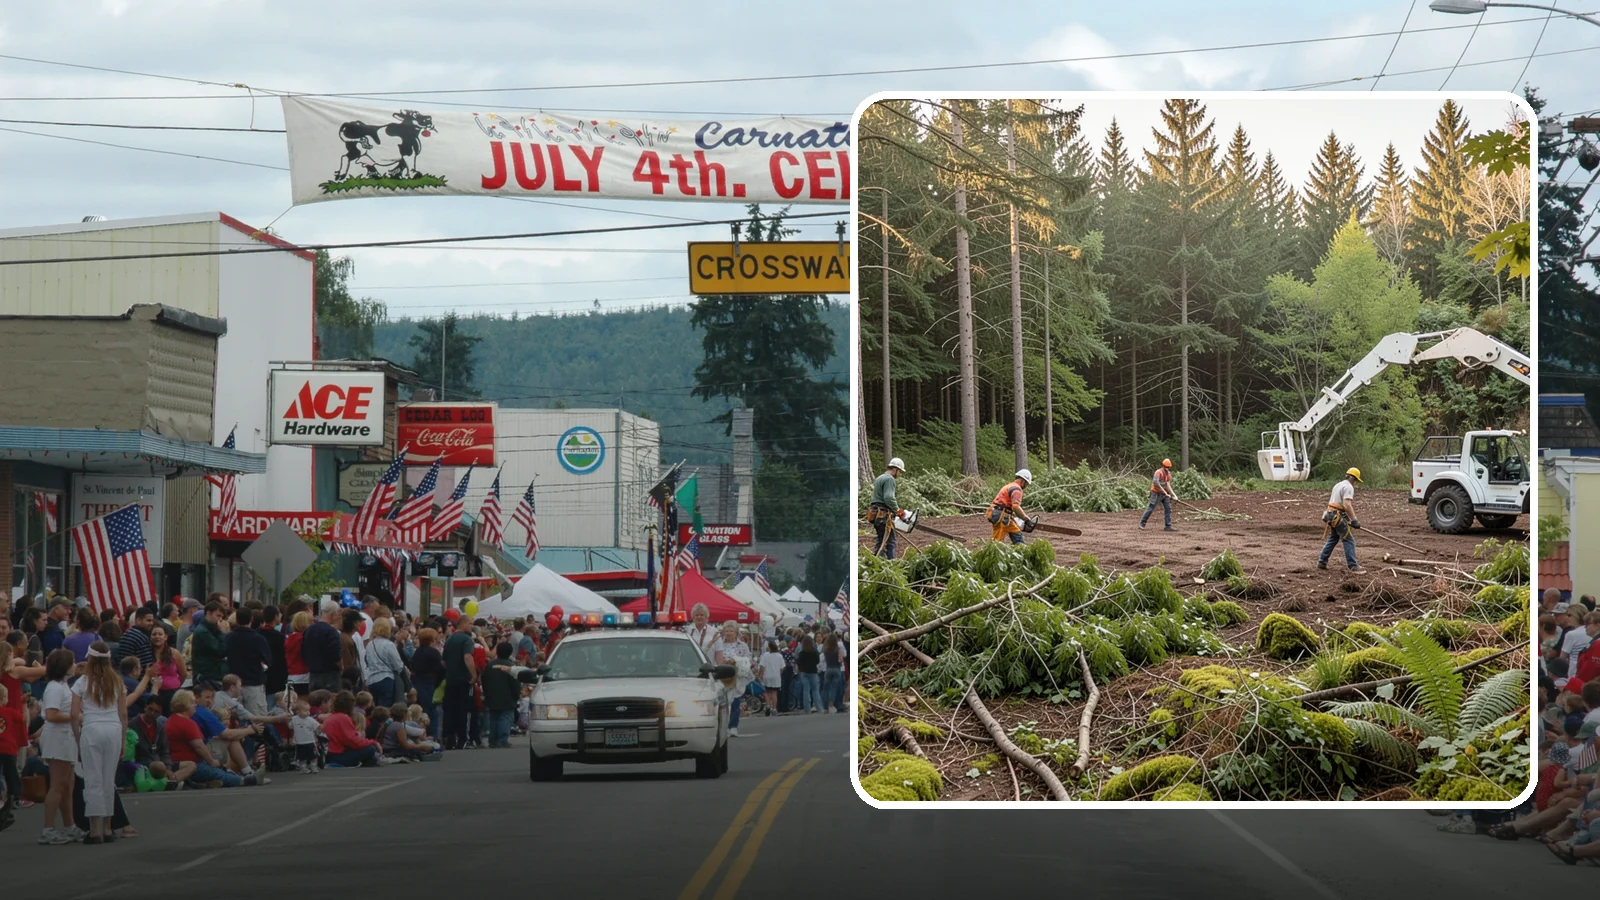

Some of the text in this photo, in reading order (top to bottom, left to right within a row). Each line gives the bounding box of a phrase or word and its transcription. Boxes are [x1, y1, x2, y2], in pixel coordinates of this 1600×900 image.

[695, 121, 850, 150] Carnat
[481, 141, 605, 193] JULY
[632, 150, 746, 197] 4th.
[696, 254, 850, 280] CROSSWA
[283, 380, 373, 419] ACE
[406, 409, 452, 422] CEDAR
[283, 421, 370, 436] Hardware
[416, 428, 477, 447] Coca-Cola
[354, 467, 386, 480] Simpl
[96, 485, 124, 494] Vincent
[126, 486, 135, 495] de
[138, 486, 155, 495] Paul
[212, 516, 331, 536] HARDARE
[688, 526, 741, 535] CRNATION
[699, 535, 730, 543] GLASS
